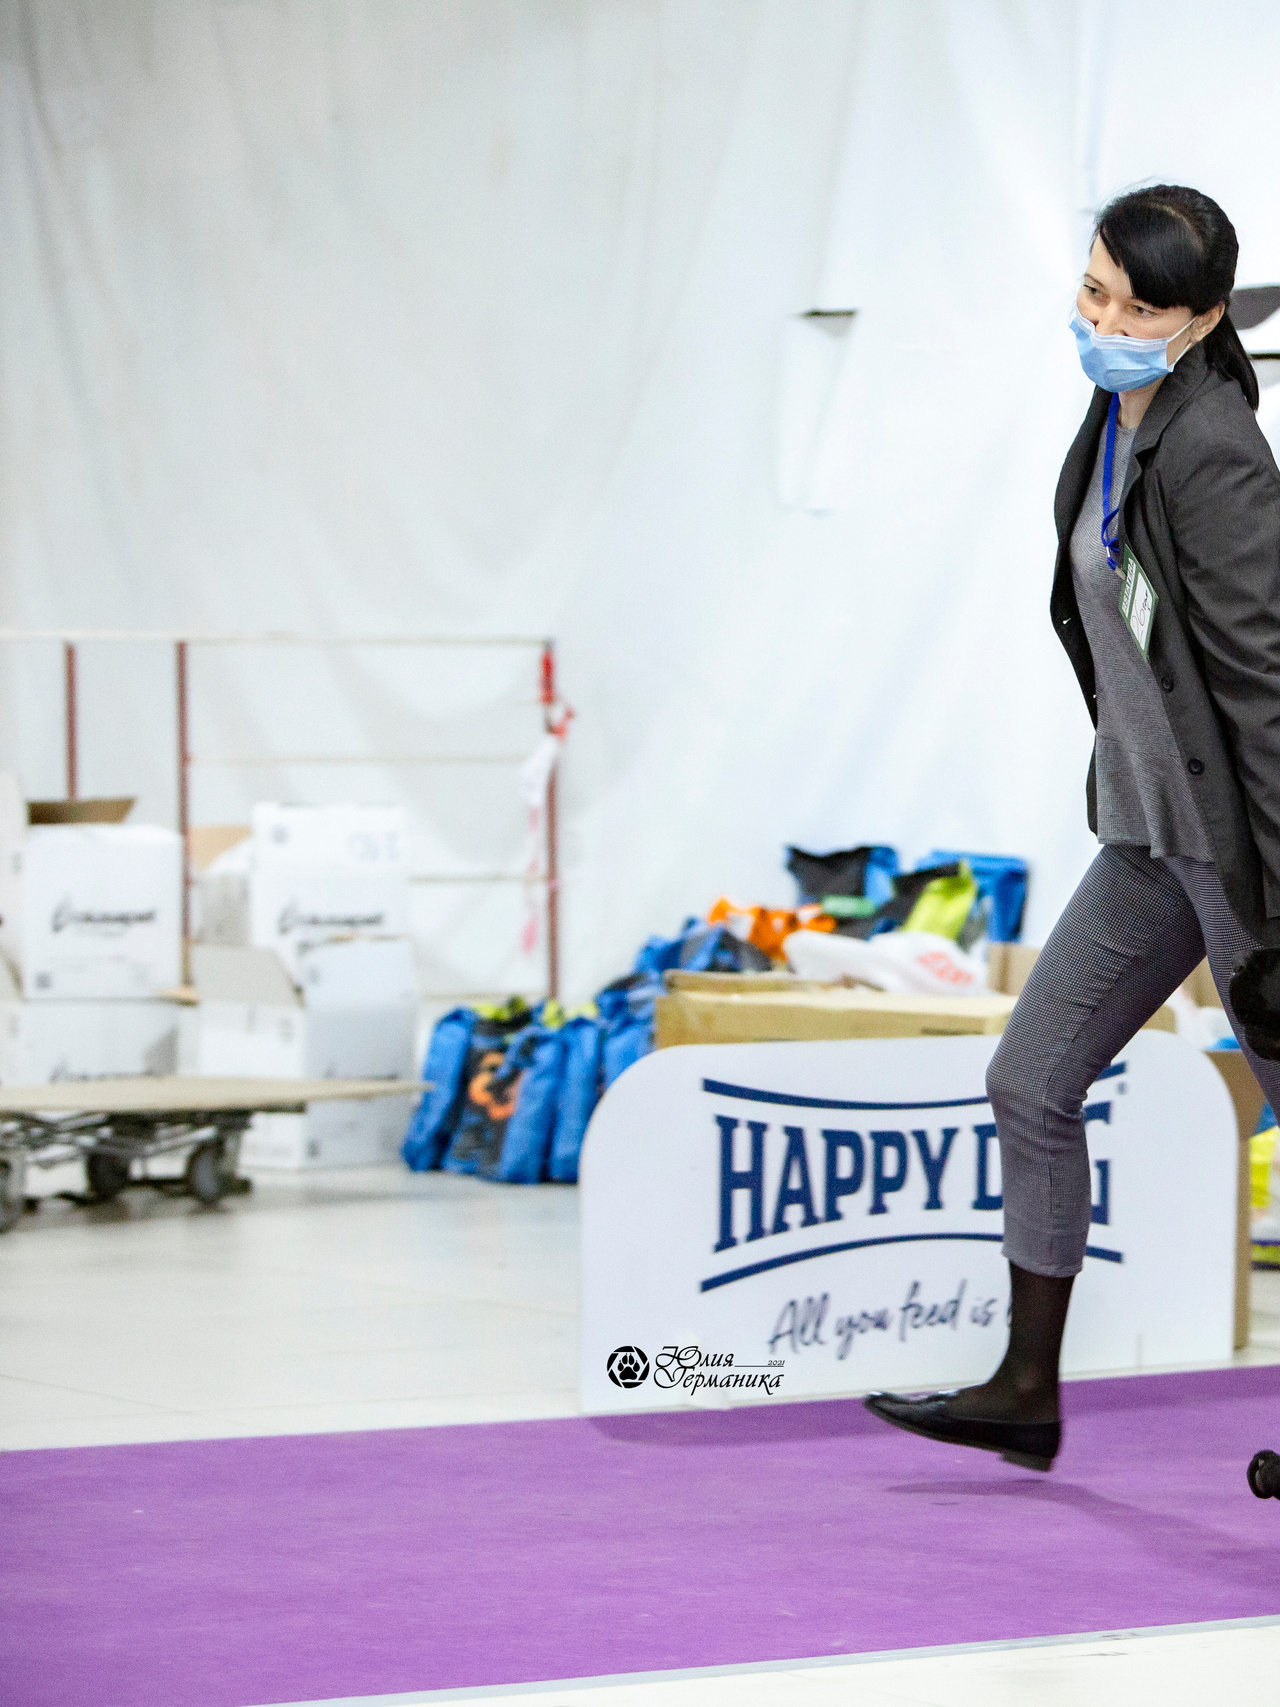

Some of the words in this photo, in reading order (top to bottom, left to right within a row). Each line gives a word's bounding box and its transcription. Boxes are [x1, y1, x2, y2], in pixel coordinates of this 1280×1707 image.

[714, 1114, 958, 1253] HAPPY
[972, 1100, 1113, 1226] DG
[768, 1292, 831, 1354] All
[899, 1280, 967, 1342] feed
[970, 1297, 998, 1328] is
